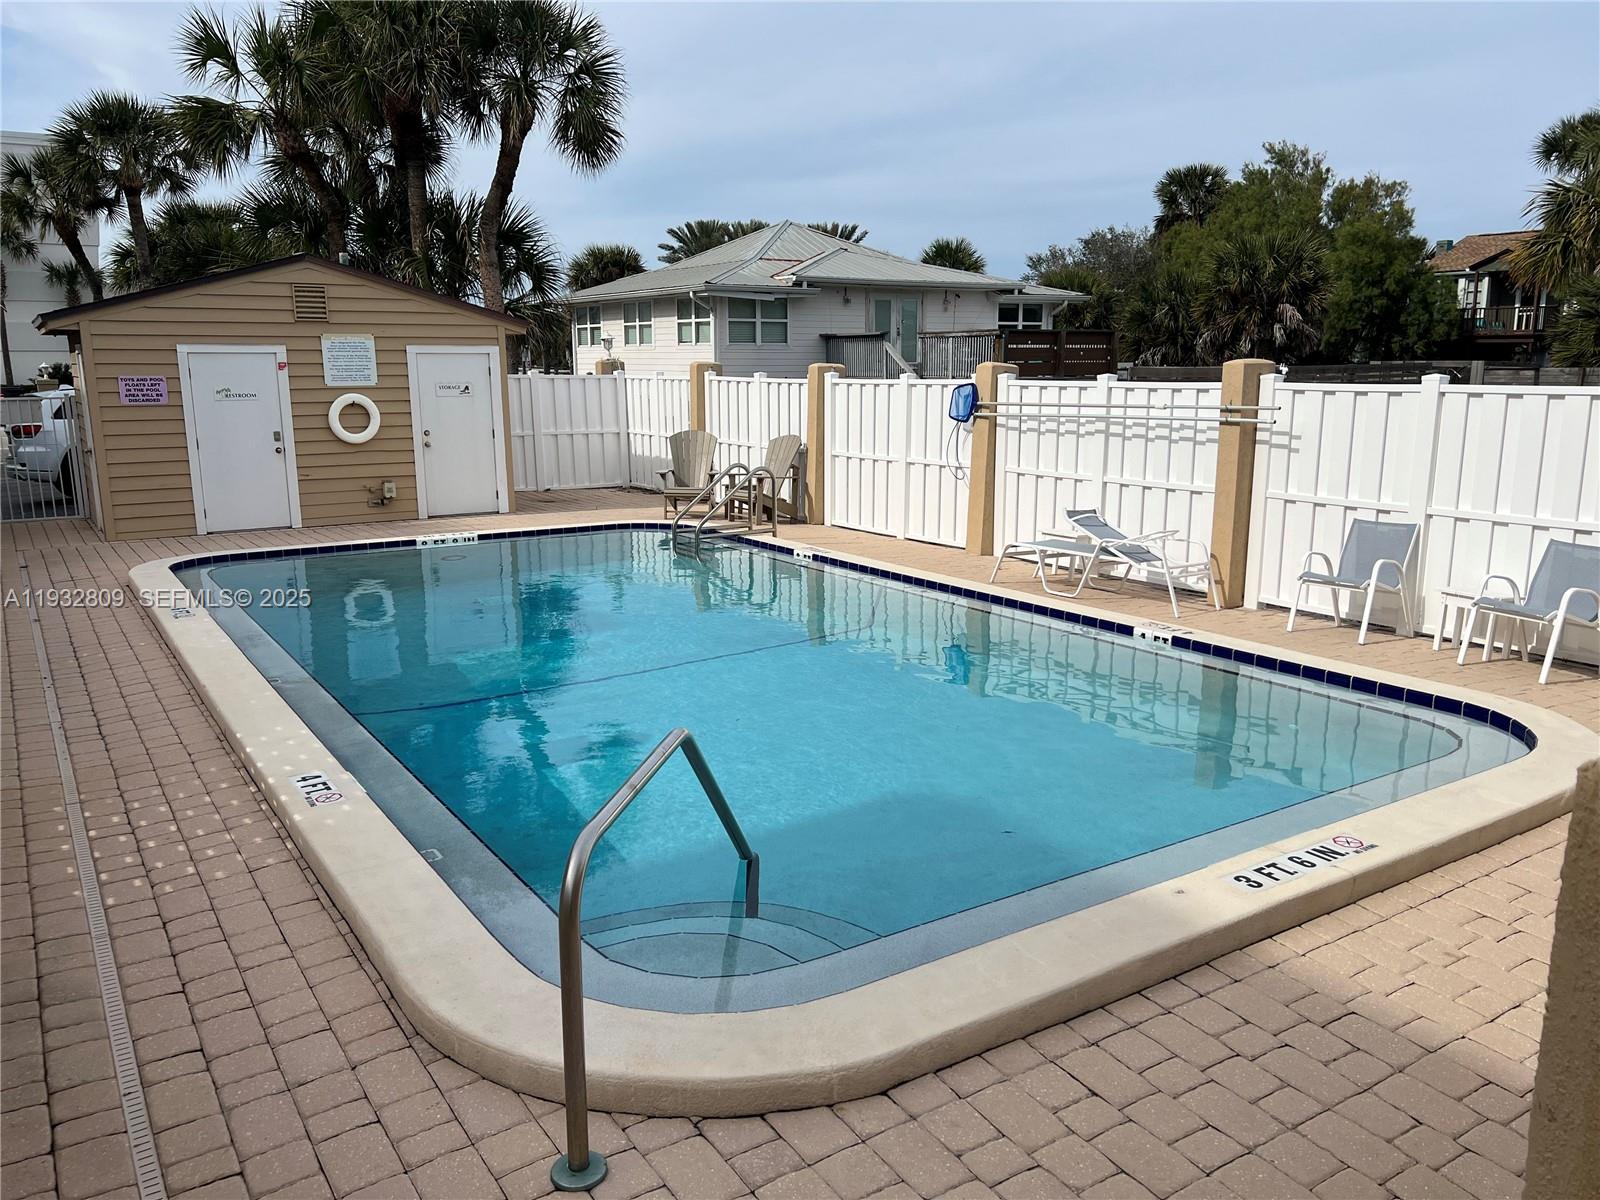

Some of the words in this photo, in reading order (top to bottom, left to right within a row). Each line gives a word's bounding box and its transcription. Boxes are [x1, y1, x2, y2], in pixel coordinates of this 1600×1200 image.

[296, 775, 322, 783] 4
[1233, 875, 1264, 889] 3
[1252, 862, 1300, 882] FT.
[1287, 855, 1317, 869] 6
[1304, 845, 1351, 863] IN.
